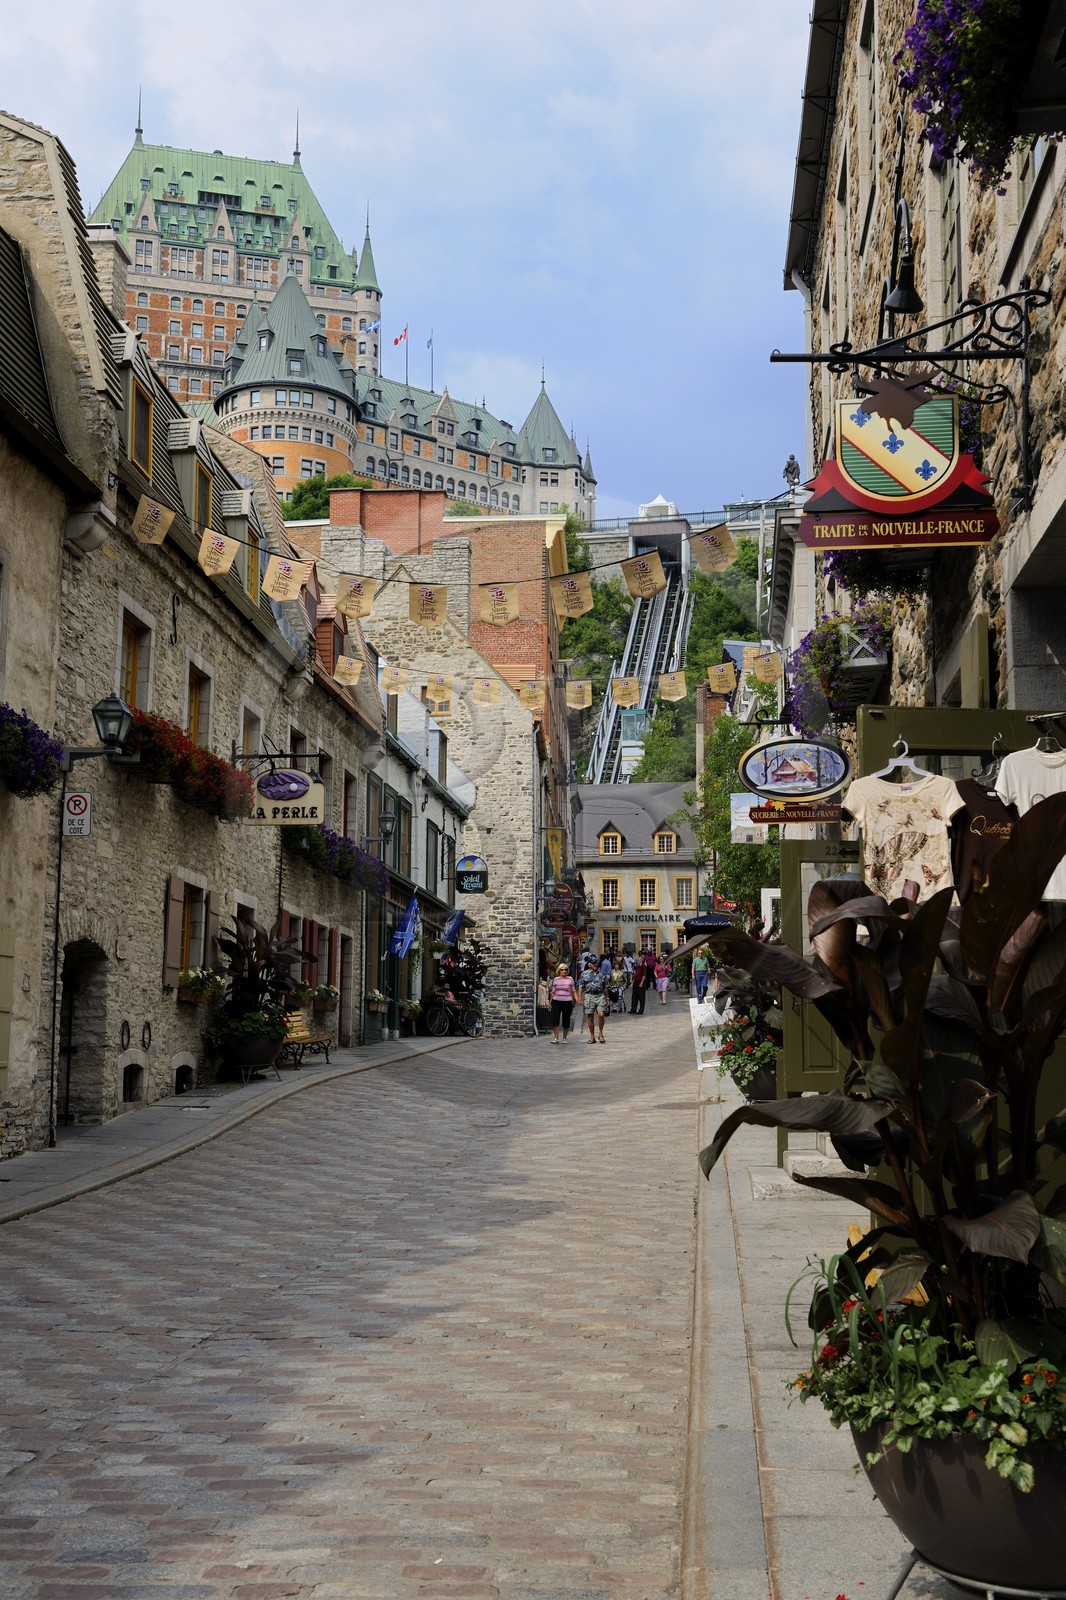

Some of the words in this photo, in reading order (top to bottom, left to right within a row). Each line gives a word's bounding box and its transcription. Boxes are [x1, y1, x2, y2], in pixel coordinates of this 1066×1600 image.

[813, 524, 856, 538] TRAITE
[872, 519, 985, 537] NOUVELLE-FRANCE
[271, 806, 318, 819] PERLE
[751, 811, 780, 819] SUCRERIE
[785, 810, 840, 819] NOUVELLE-FRANCE
[68, 818, 76, 826] DE
[77, 818, 85, 826] CE
[463, 874, 480, 883] Soleil
[460, 880, 483, 891] Levant
[615, 914, 682, 923] FUNICULAIRE
